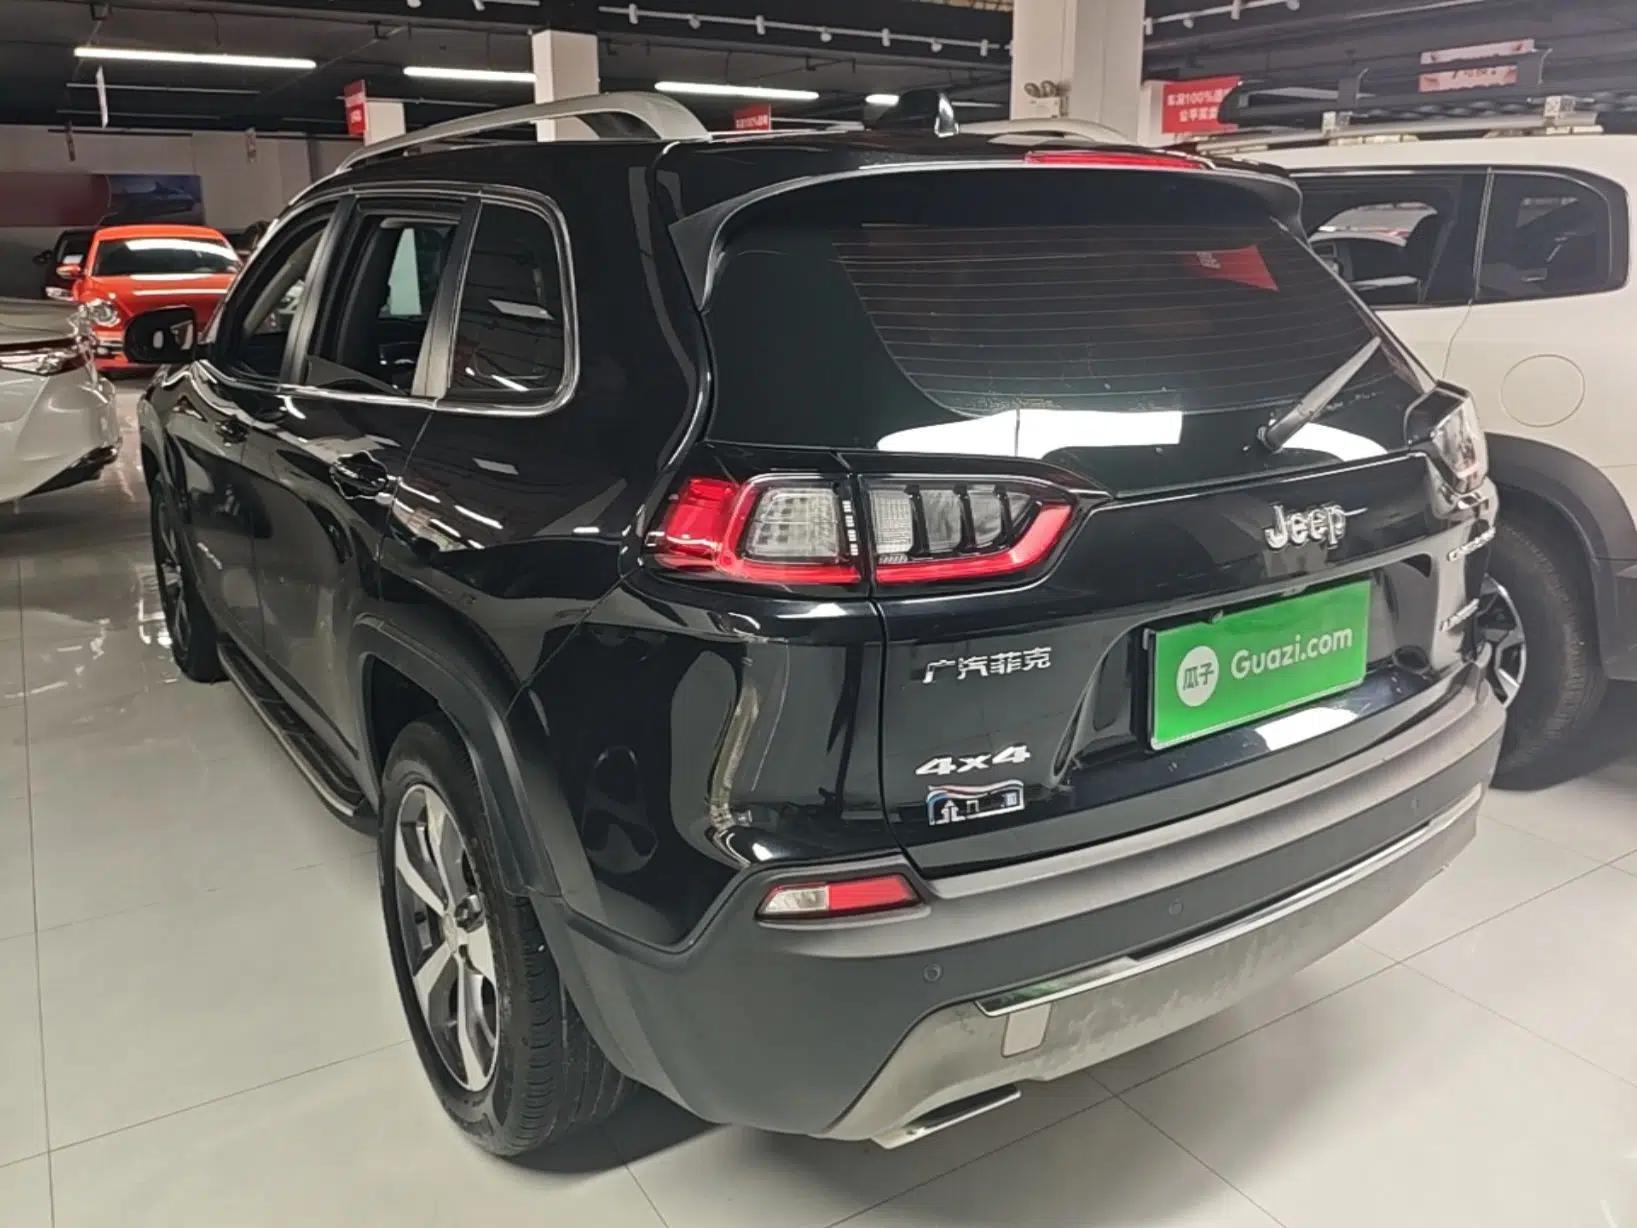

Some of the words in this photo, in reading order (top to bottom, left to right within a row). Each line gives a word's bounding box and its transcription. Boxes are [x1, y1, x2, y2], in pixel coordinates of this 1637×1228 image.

[1264, 504, 1348, 550] Jeep
[922, 646, 1052, 684] 广汽菲克
[1230, 627, 1353, 679] Guazi.com
[1183, 661, 1215, 691] 瓜子
[914, 744, 1032, 776] 4x4
